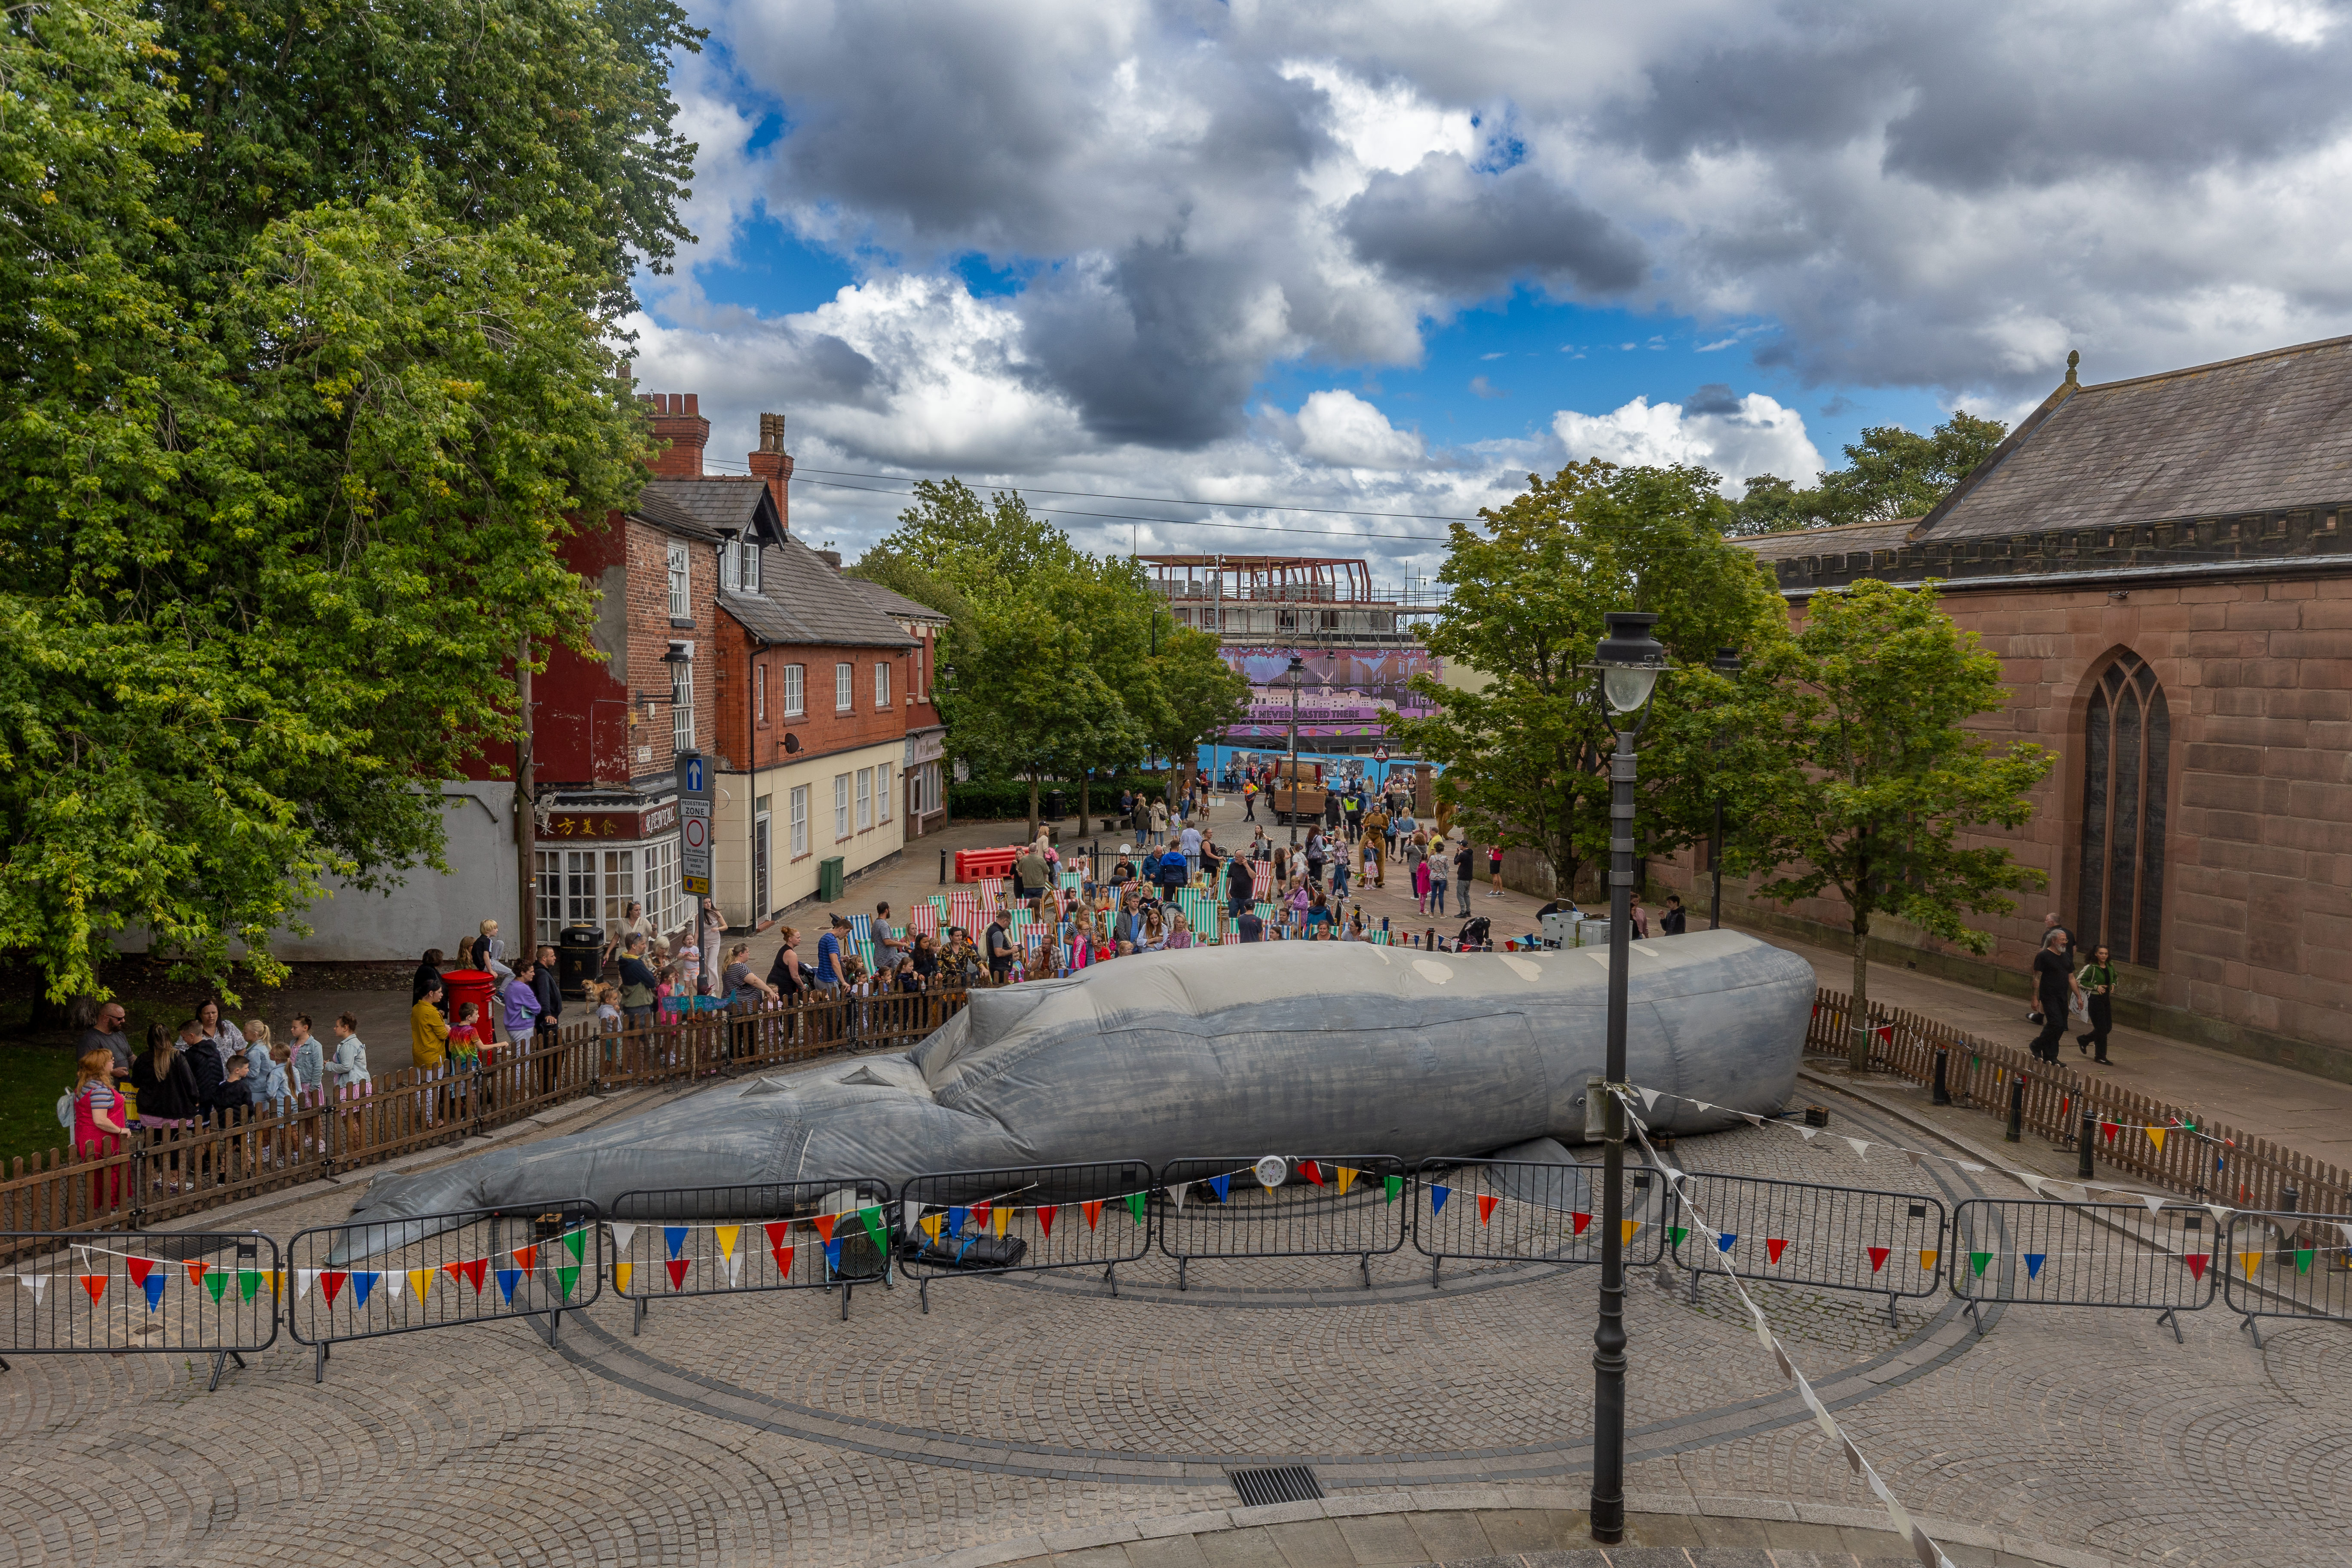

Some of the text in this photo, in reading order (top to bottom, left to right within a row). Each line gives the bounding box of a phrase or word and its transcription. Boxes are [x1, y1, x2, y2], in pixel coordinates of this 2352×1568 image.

[1259, 710, 1291, 718] NEVER
[1332, 710, 1360, 718] THERE
[686, 807, 704, 815] ZONE
[641, 805, 674, 833] ORIENTAL
